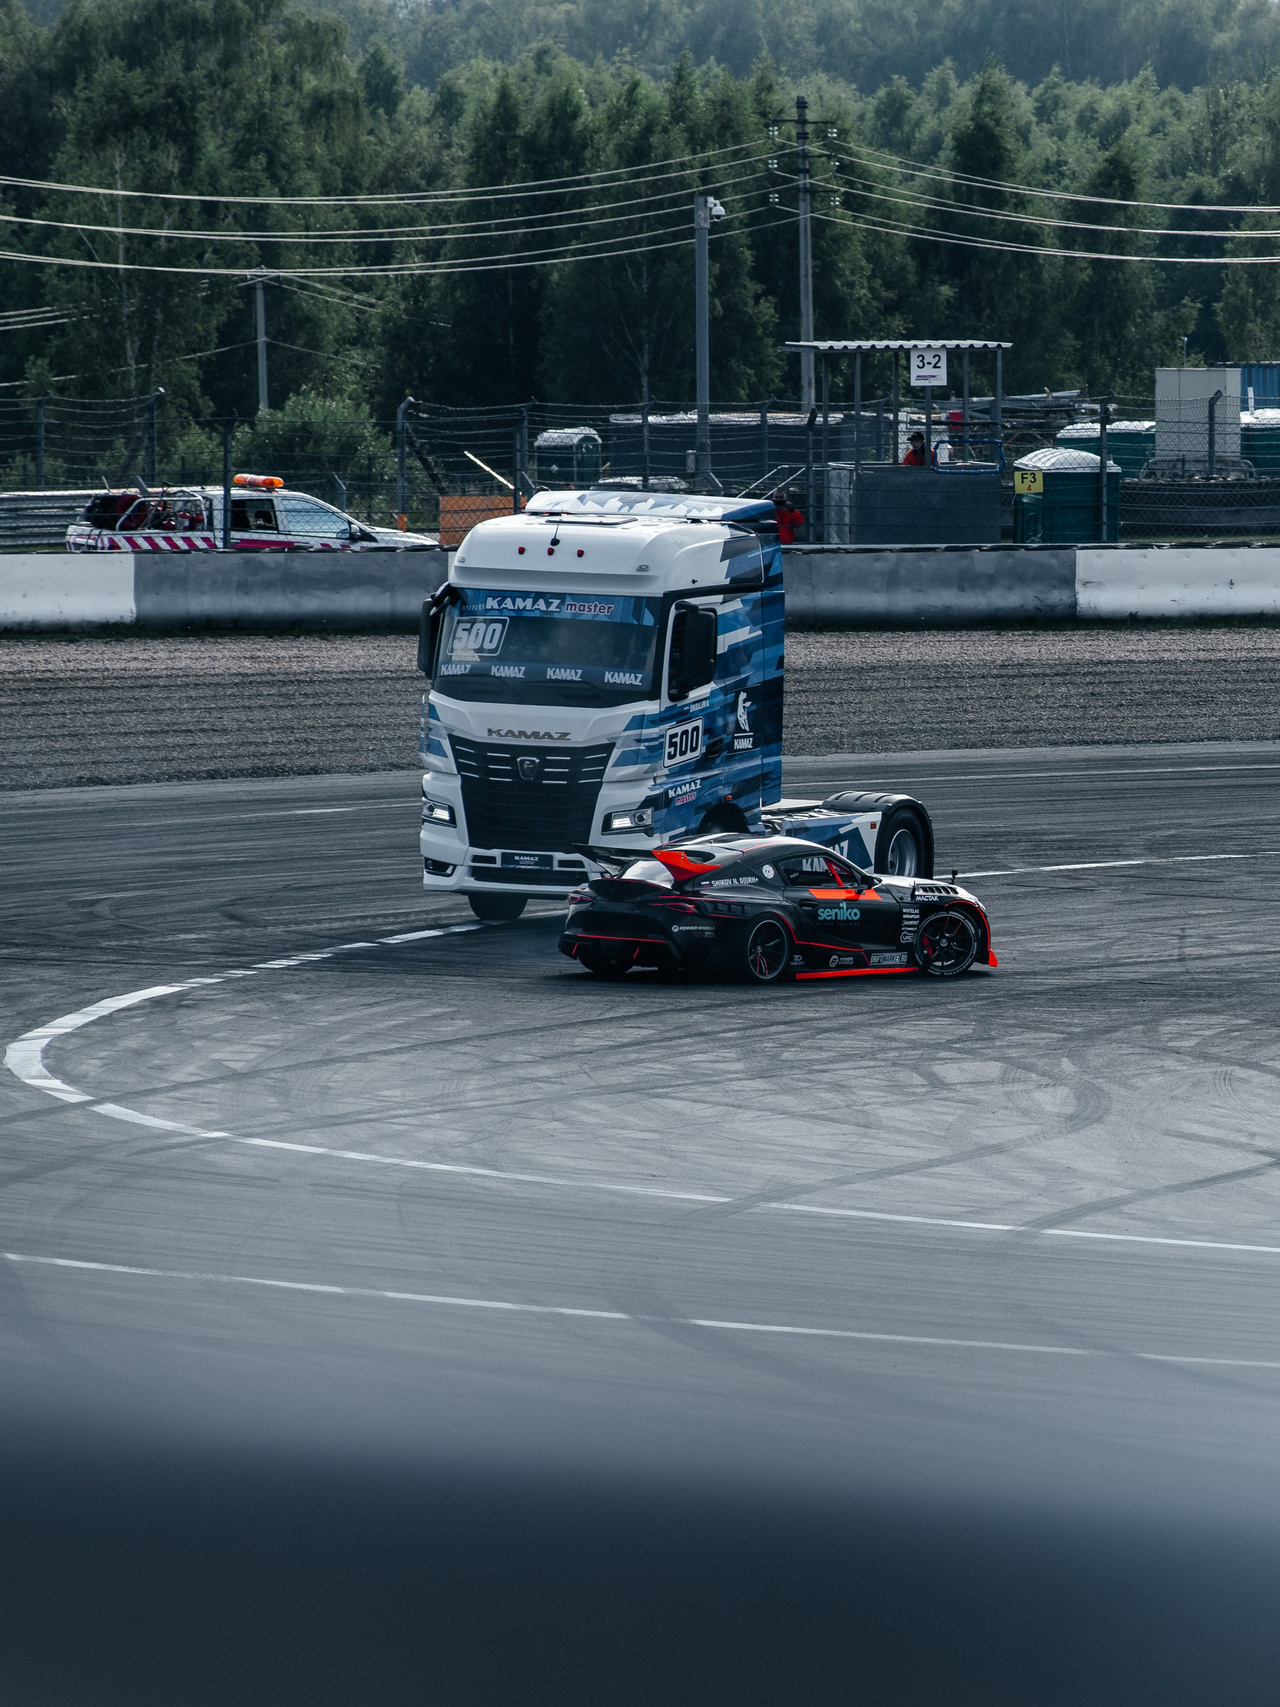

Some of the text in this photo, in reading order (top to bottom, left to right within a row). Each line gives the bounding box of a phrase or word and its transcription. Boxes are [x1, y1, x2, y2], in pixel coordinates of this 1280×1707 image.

[916, 354, 941, 369] 3-2
[1020, 472, 1037, 484] F3
[485, 597, 562, 612] KAMAZ
[565, 602, 614, 615] master
[453, 622, 503, 650] 500
[440, 664, 471, 676] KAMAZ
[491, 665, 526, 678] KAMAZ
[546, 668, 582, 681] KAMAZ
[604, 671, 643, 685] KAMAZ
[487, 727, 572, 741] KAMAZ
[667, 725, 700, 760] 500
[734, 738, 753, 749] KAMAZ
[668, 780, 702, 798] KAMAZ
[675, 792, 697, 806] master
[818, 902, 861, 920] seniko
